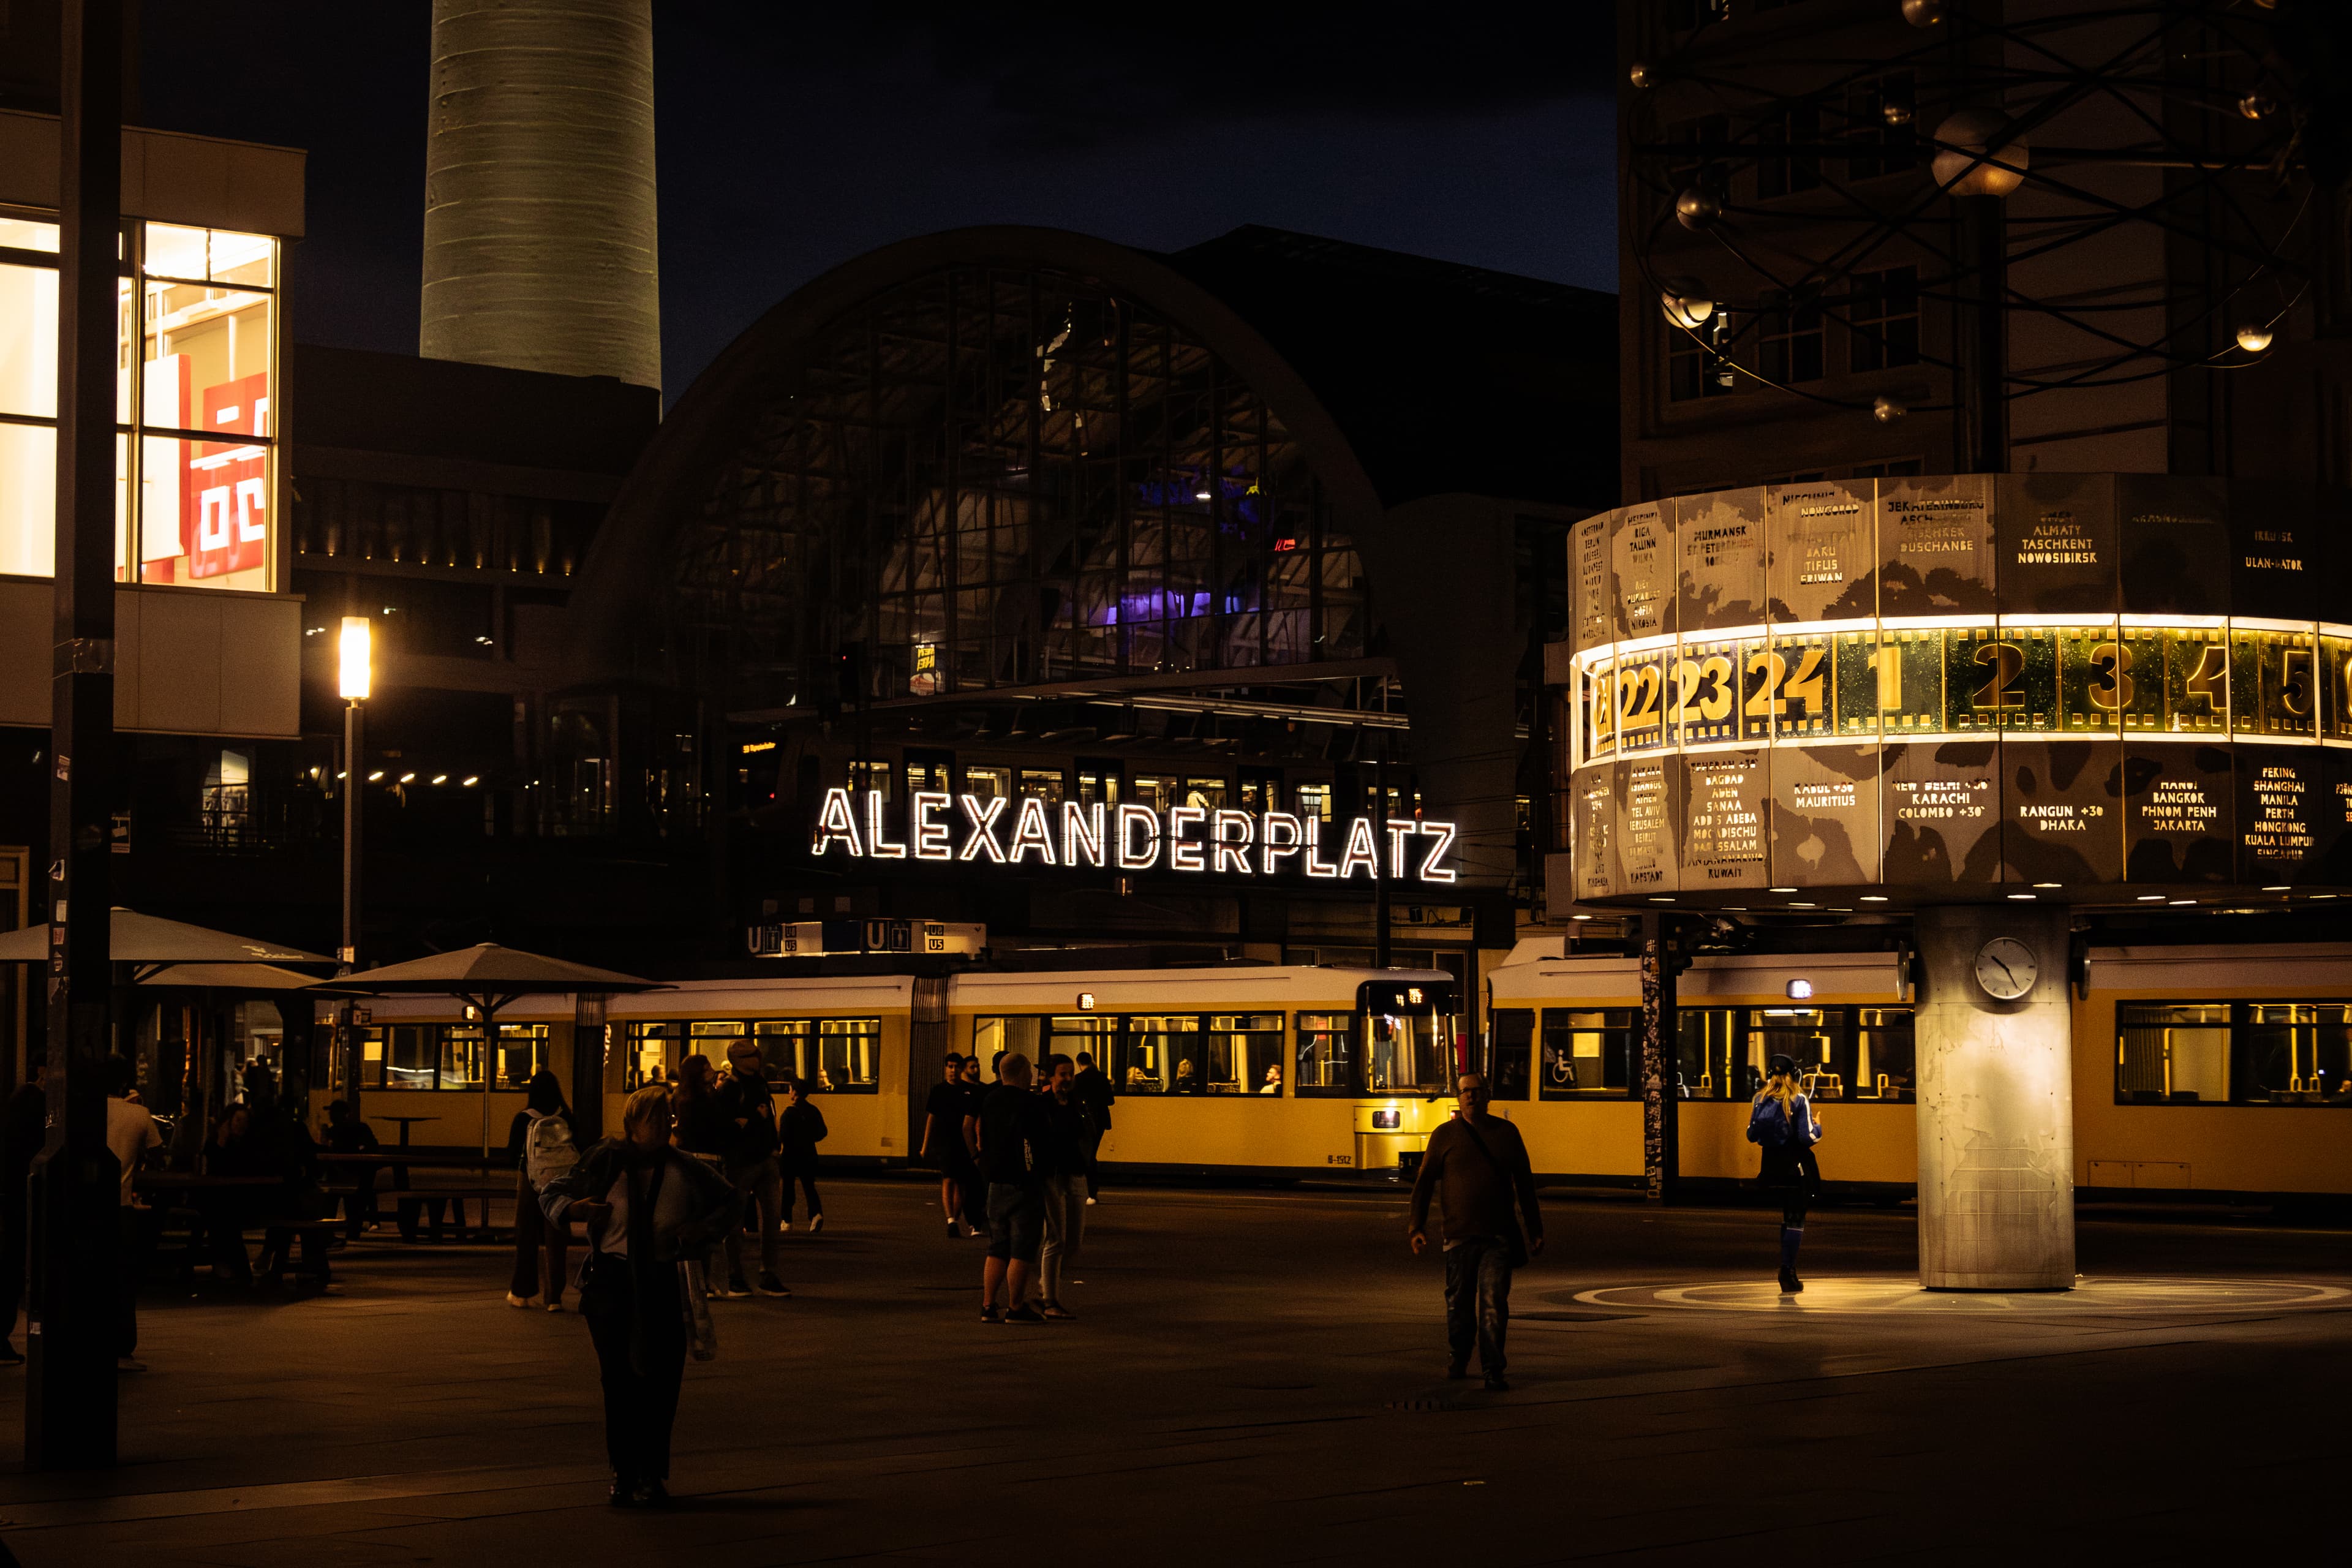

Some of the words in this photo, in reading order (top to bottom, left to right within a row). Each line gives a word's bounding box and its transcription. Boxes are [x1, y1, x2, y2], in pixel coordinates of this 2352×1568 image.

[1801, 504, 1859, 518] NOWGOROD
[1635, 526, 1651, 538] RIGA
[1694, 526, 1746, 541] MURMANSK
[2034, 525, 2081, 536] ALMATY
[1630, 537, 1656, 552] TALLINN
[2022, 539, 2093, 549] TASCHKENT
[2018, 552, 2097, 564] NOWOSIBIRSK
[1806, 559, 1838, 571] TIFLIS
[1801, 573, 1842, 585] ERIWAN
[1868, 647, 1902, 710] 1
[1972, 643, 2025, 709] 2
[2089, 643, 2134, 709] 3
[2187, 646, 2227, 710] 4
[1746, 650, 1826, 717] 24
[2283, 650, 2316, 715] 5
[1668, 656, 1732, 723] 23
[1621, 665, 1661, 731] 22
[2262, 767, 2296, 778] PEKING
[1705, 774, 1744, 786] BAGDAD
[1893, 780, 1917, 791] NEW
[2253, 780, 2305, 793] SHANGHAI
[1796, 795, 1856, 808] MAURITIUS
[1912, 793, 1970, 805] KARACHI
[2153, 792, 2206, 804] BANGKOK
[2261, 794, 2299, 806] MANILA
[1631, 807, 1643, 818] TEL
[1645, 805, 1660, 816] AVIV
[1706, 800, 1743, 812] SANAA
[2019, 805, 2073, 818] RANGUN
[2142, 805, 2182, 818] PHNOM
[2187, 806, 2217, 818] PENH
[1898, 807, 1953, 819] COLOMBO
[2266, 807, 2294, 819] PERTH
[1694, 814, 1722, 826] ADDS
[1725, 813, 1757, 825] ABEBA
[2040, 819, 2087, 831] DHAKA
[2153, 820, 2206, 832] JAKARTA
[2255, 821, 2307, 833] HONGKONG
[811, 787, 1457, 884] ALEXANDERPLATZ
[2245, 834, 2276, 846] KUALA
[1708, 867, 1742, 878] KUWAIT
[867, 921, 885, 949] U
[930, 940, 943, 950] U5
